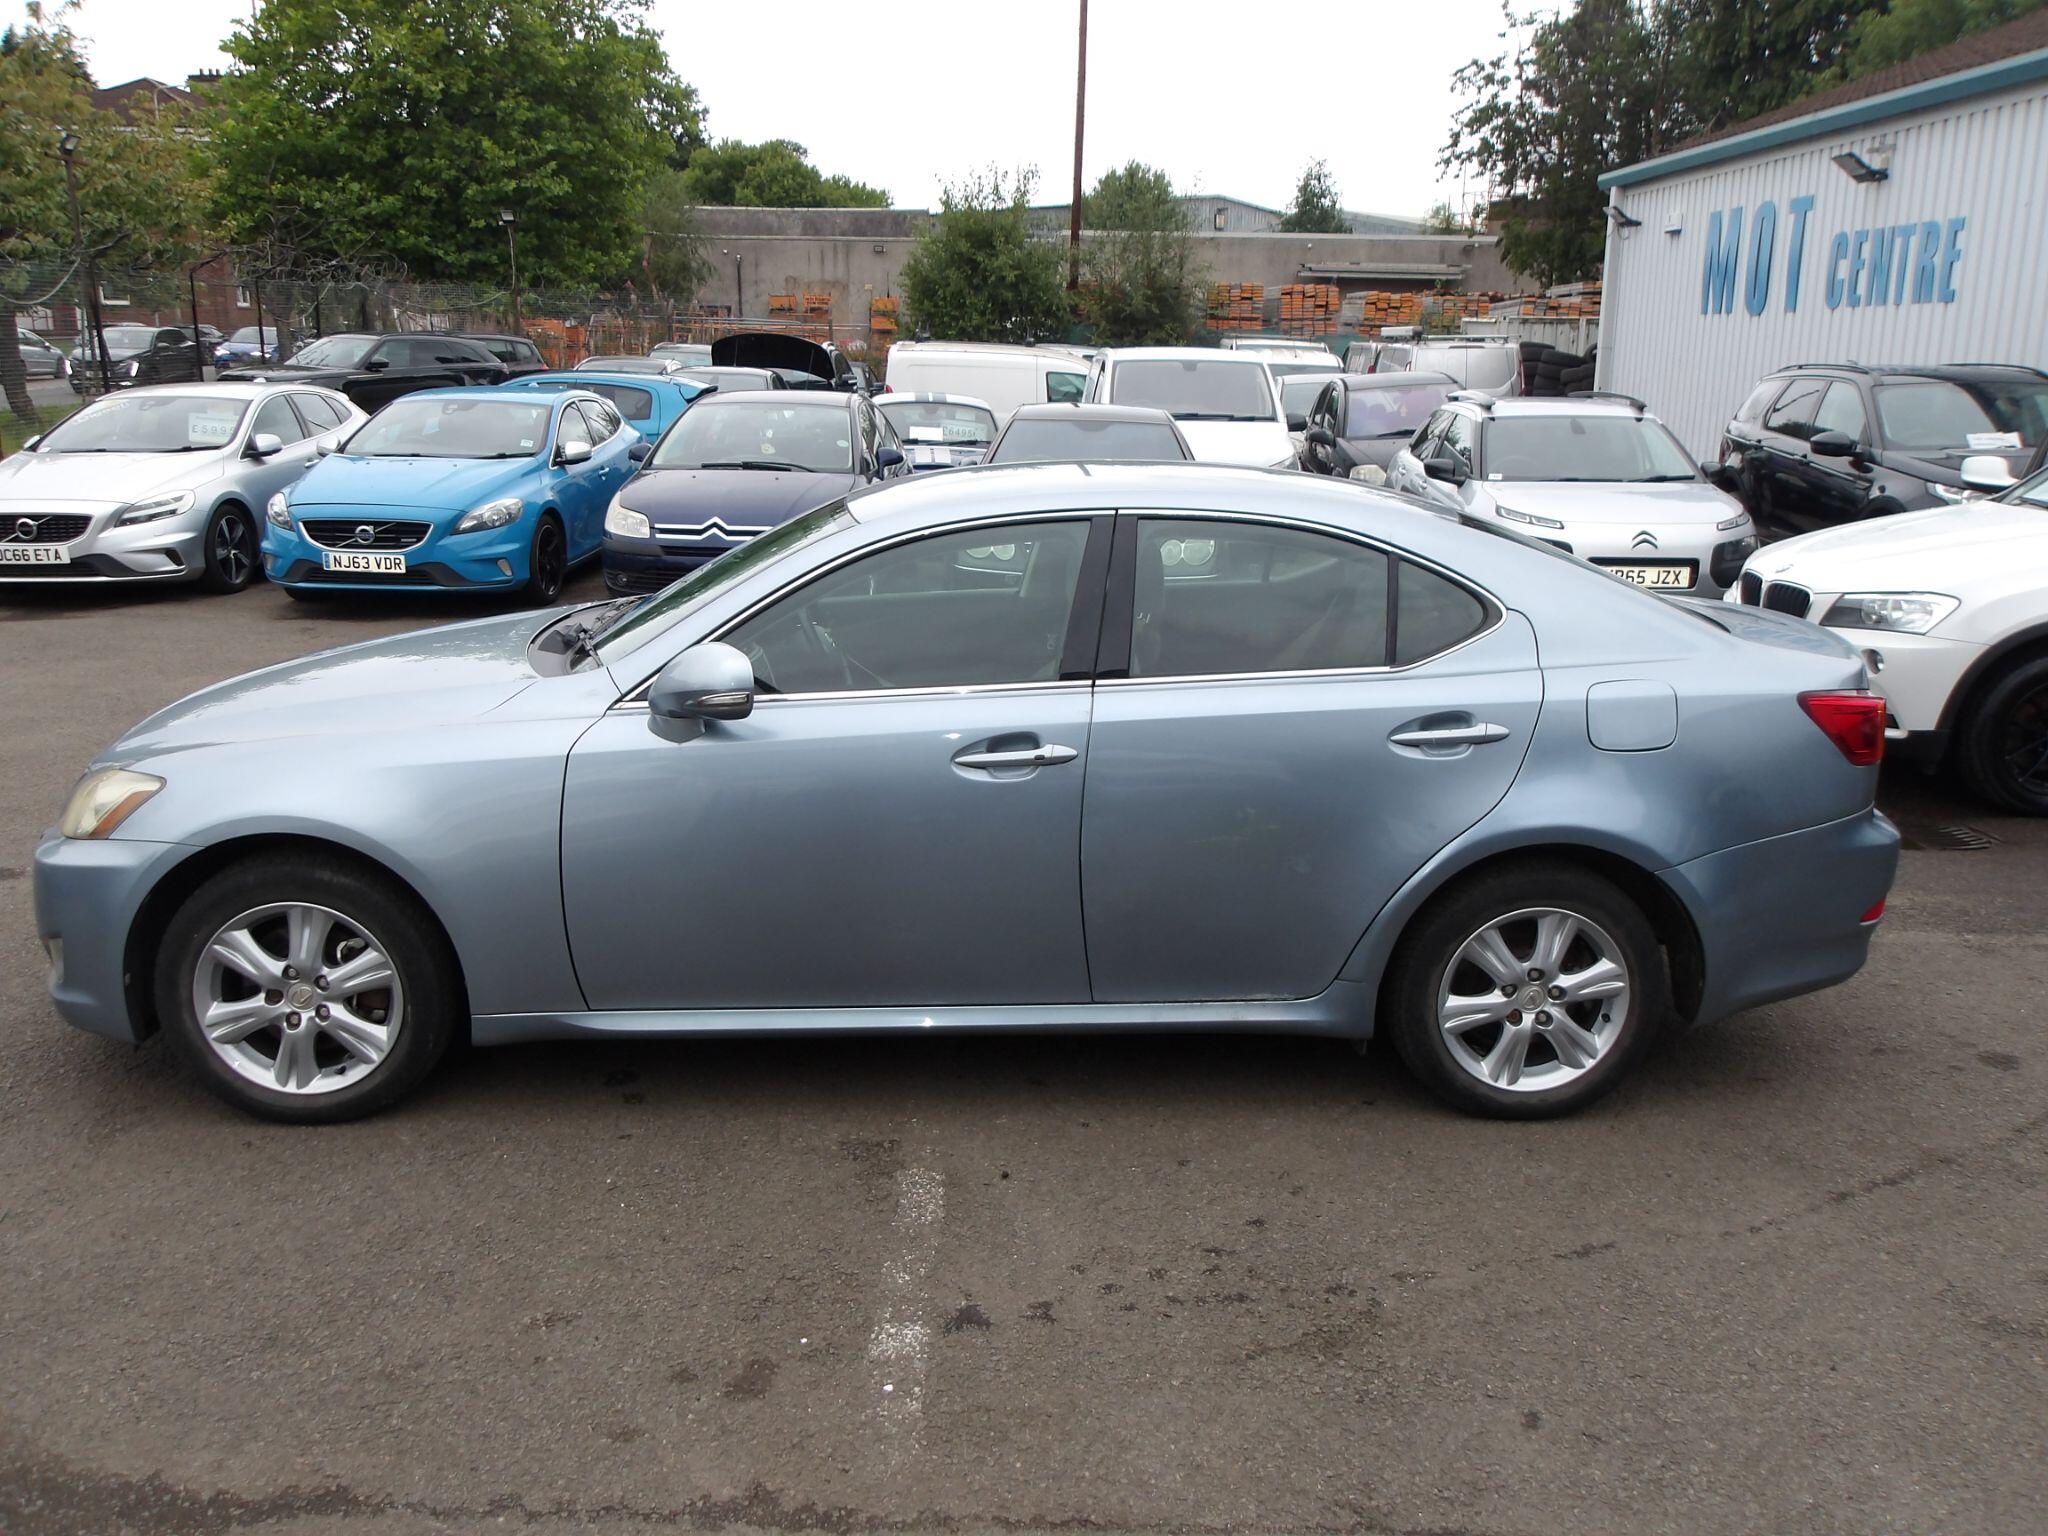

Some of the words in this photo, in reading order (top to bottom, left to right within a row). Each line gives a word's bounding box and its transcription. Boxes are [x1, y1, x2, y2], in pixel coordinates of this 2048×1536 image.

[1701, 194, 1815, 316] MOT
[1825, 216, 1966, 309] CENTRE
[34, 548, 62, 561] ETA
[333, 555, 370, 569] NJ63
[374, 556, 402, 570] VDR
[1651, 570, 1681, 585] JZX
